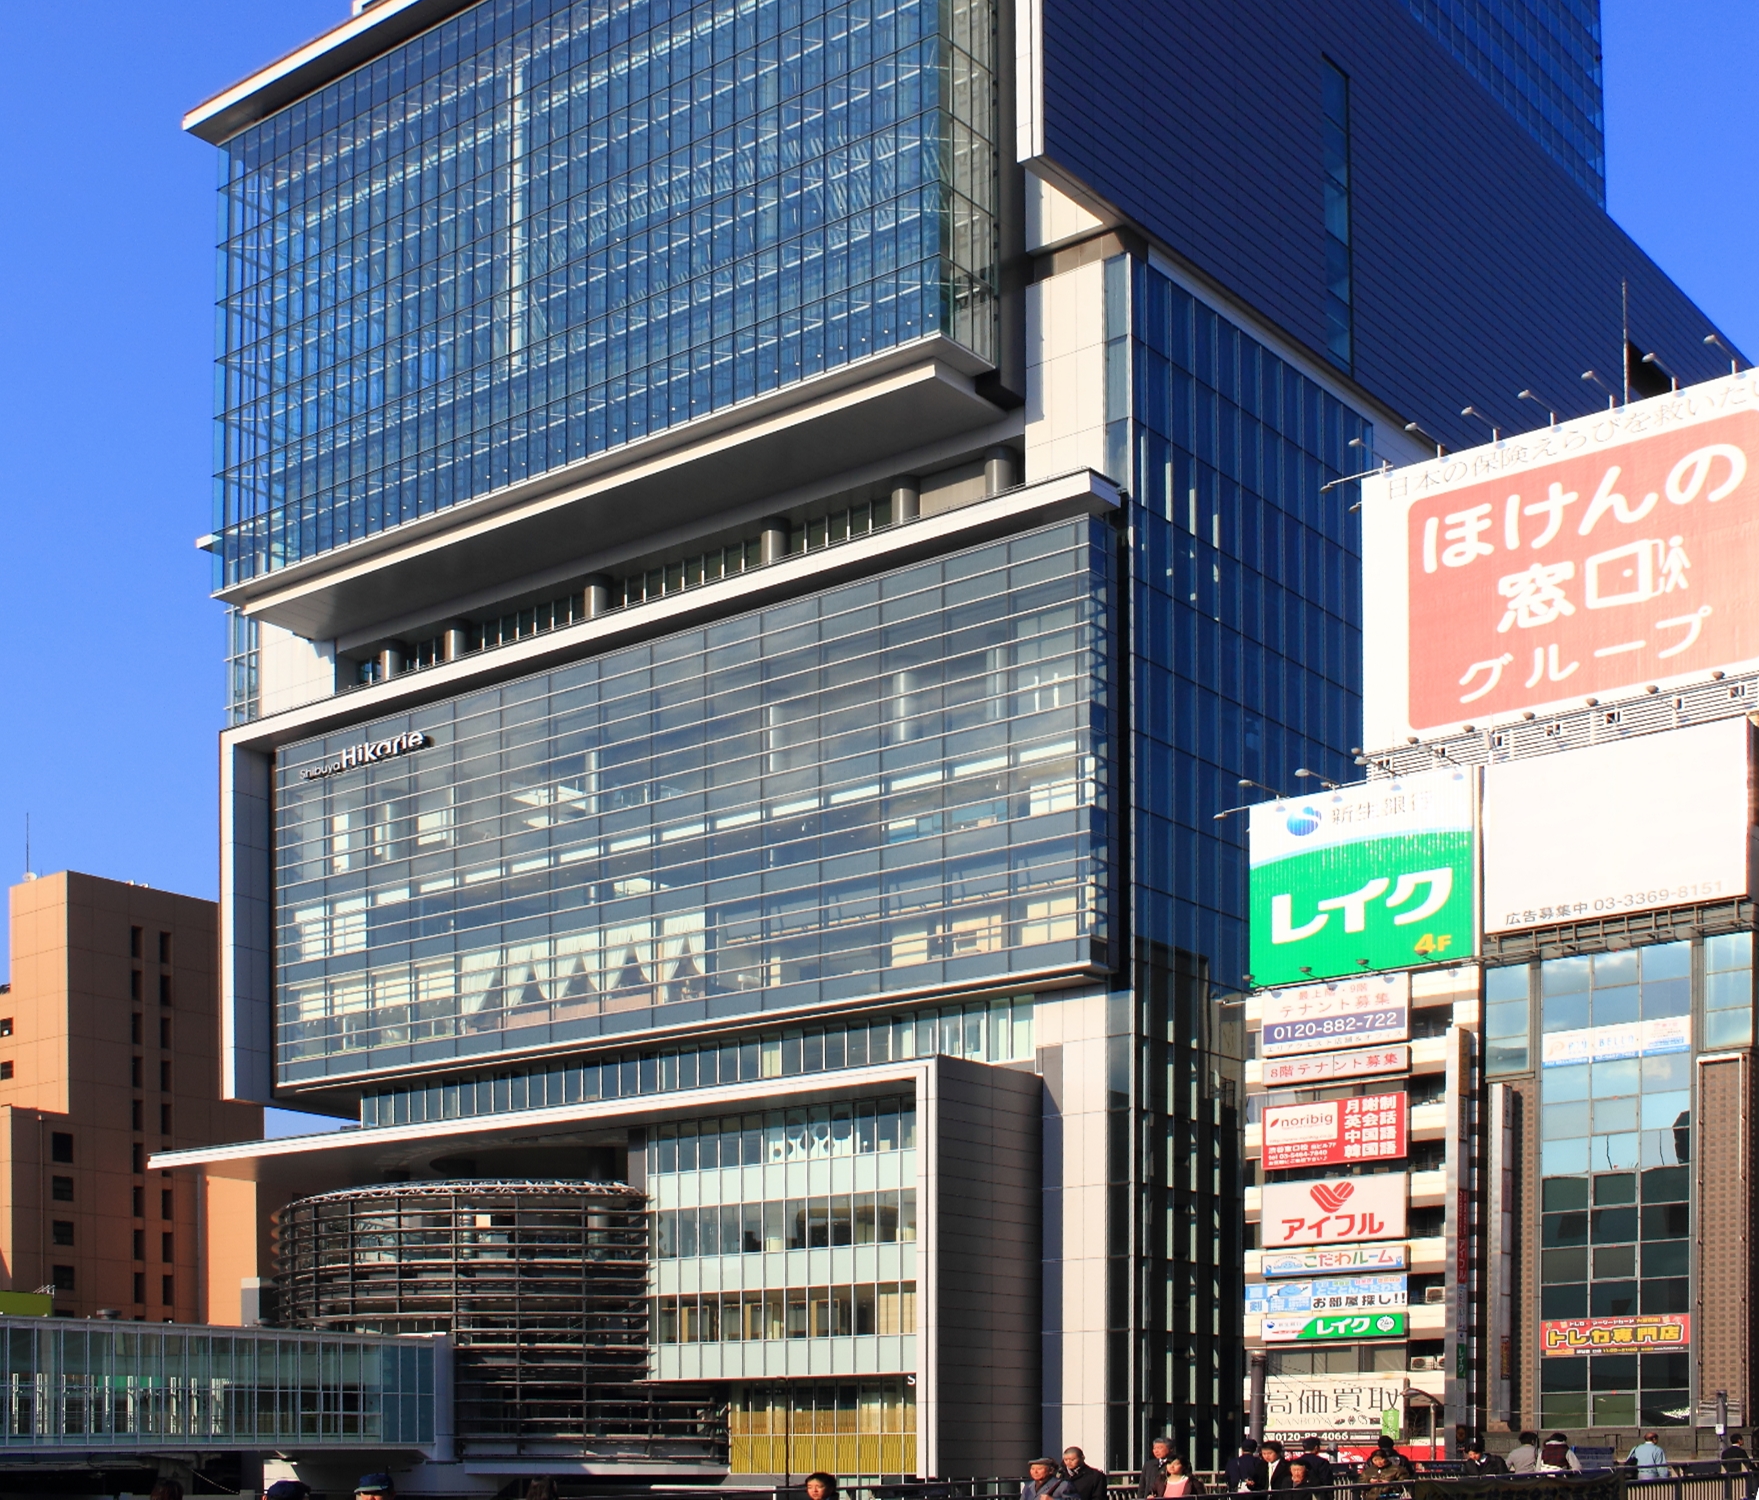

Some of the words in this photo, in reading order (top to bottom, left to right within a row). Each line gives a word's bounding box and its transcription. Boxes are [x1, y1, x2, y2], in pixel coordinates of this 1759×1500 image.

[1423, 443, 1747, 574] ほけんの
[1497, 538, 1660, 632] 窓口
[1459, 605, 1713, 705] グループ
[299, 761, 341, 780] Shibuya
[341, 730, 424, 768] Hikarie
[1331, 790, 1433, 825] 新生銀行
[1271, 867, 1453, 945] レイク
[1505, 901, 1588, 926] 広告募集中
[1593, 880, 1723, 912] 03-3369-8151
[1414, 934, 1452, 953] 4F
[1280, 992, 1391, 1018] テナント募集
[1273, 1012, 1397, 1040] 0120-882-722
[1270, 1052, 1398, 1078] 8階テナント募集
[1345, 1095, 1397, 1113] 月謝制
[1281, 1112, 1334, 1129] noribig
[1344, 1111, 1397, 1129] 英会話
[1344, 1126, 1397, 1143] 中国語
[1344, 1141, 1397, 1158] 韓国語
[1281, 1213, 1385, 1242] アイフル
[1304, 1249, 1394, 1268] こだわルーム
[1313, 1293, 1406, 1309] お部屋探し!!
[1316, 1317, 1372, 1336] レイク
[1547, 1325, 1682, 1347] トレカ専門店
[1266, 1387, 1401, 1415] 高価買取
